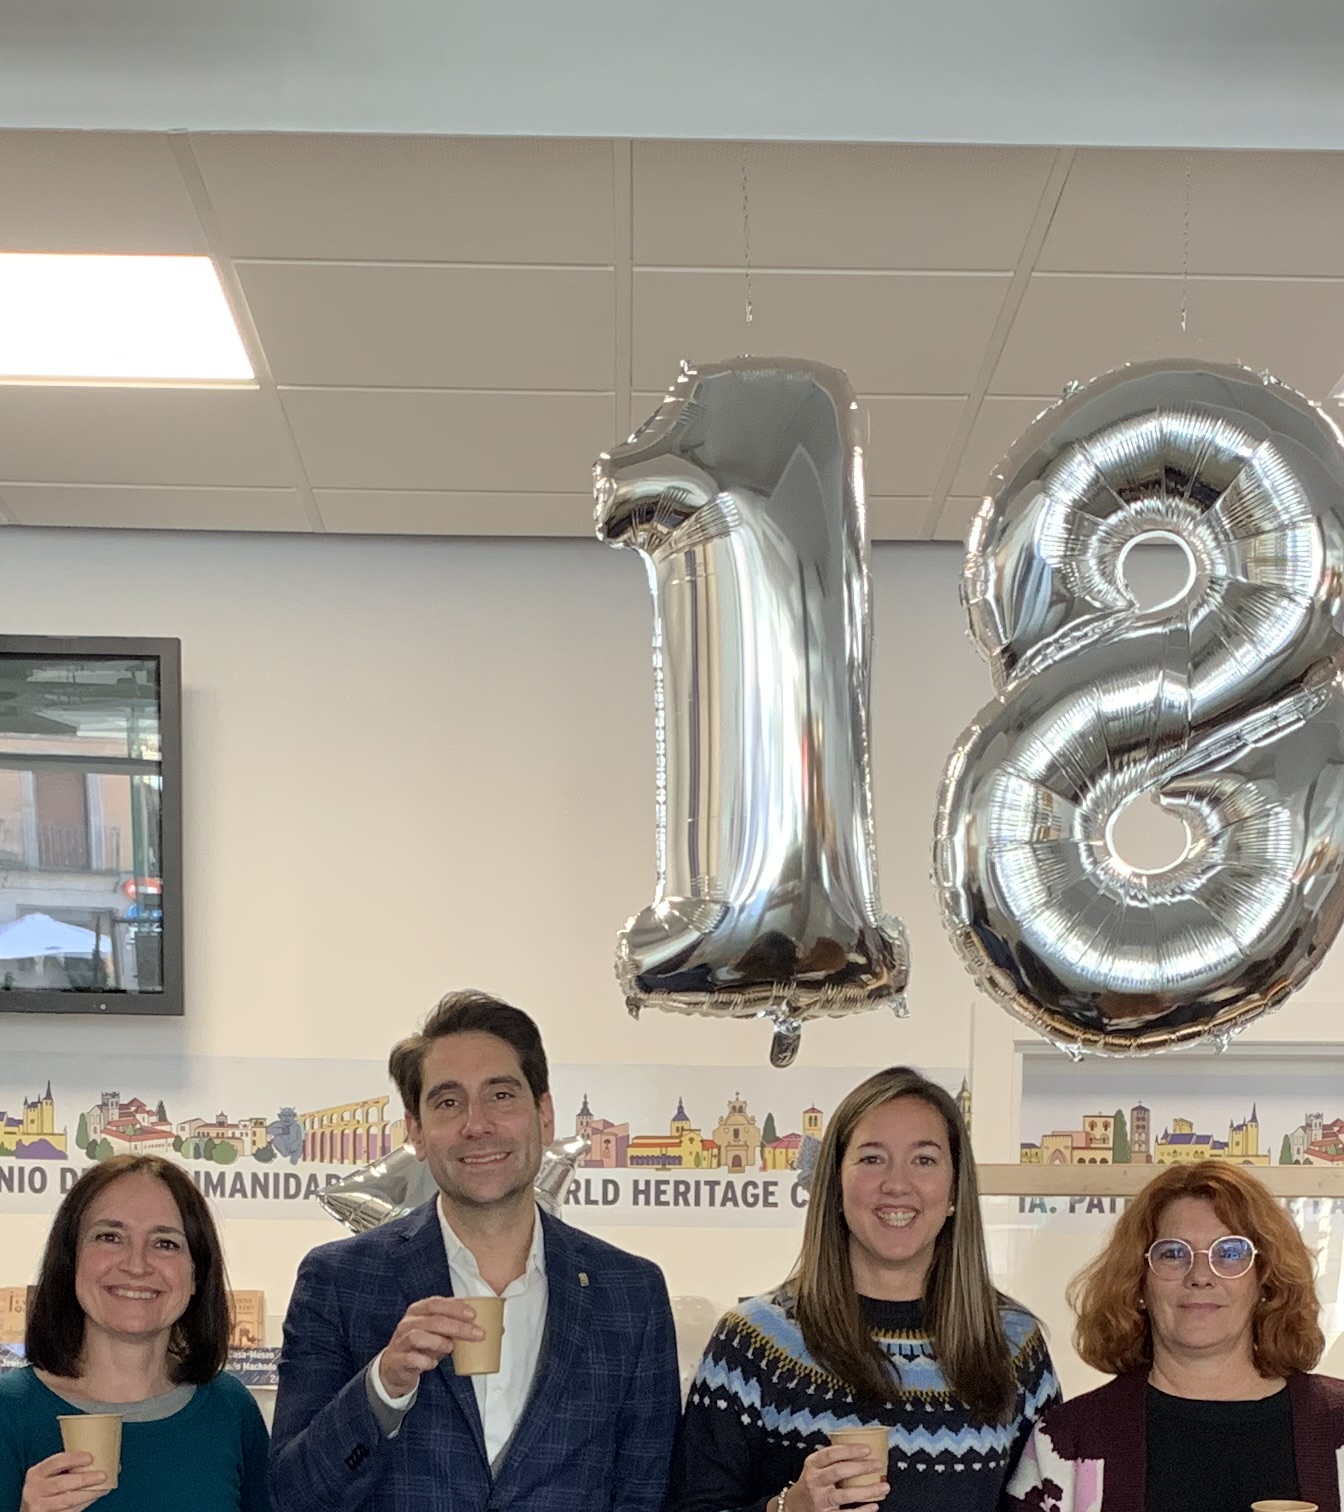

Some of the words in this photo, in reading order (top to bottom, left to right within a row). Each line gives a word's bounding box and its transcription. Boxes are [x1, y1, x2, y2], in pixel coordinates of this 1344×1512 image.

[59, 1166, 88, 1195] D
[193, 1170, 343, 1200] MANIDA
[563, 1178, 620, 1207] RLD
[632, 1179, 779, 1208] HERITAGE
